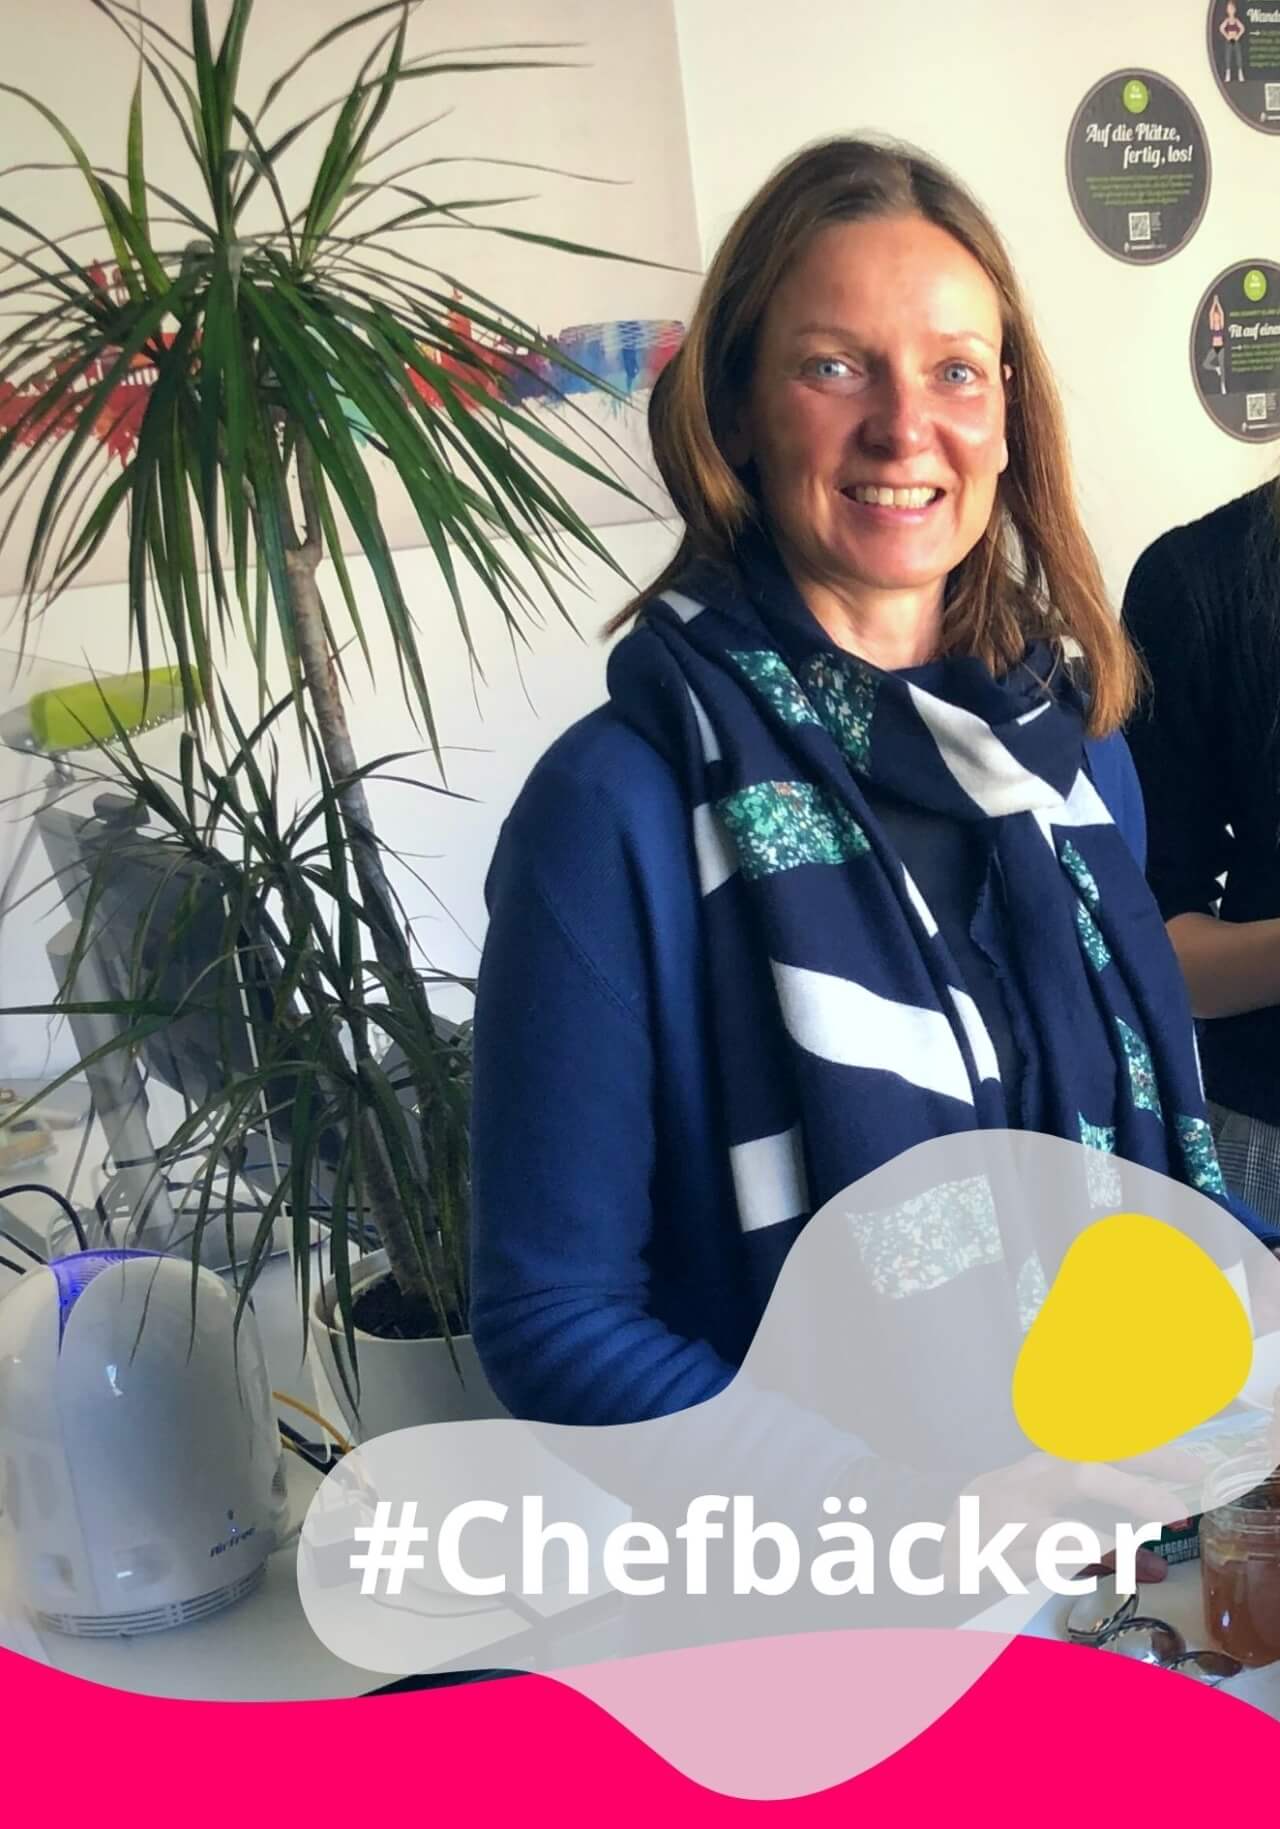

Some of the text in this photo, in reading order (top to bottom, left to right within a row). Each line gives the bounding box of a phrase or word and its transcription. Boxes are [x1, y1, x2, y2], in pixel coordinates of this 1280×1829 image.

[1086, 123, 1181, 148] Auf die Plätze,
[1123, 145, 1193, 169] fertig, los!
[1228, 324, 1242, 338] Fit
[1243, 322, 1260, 341] auf
